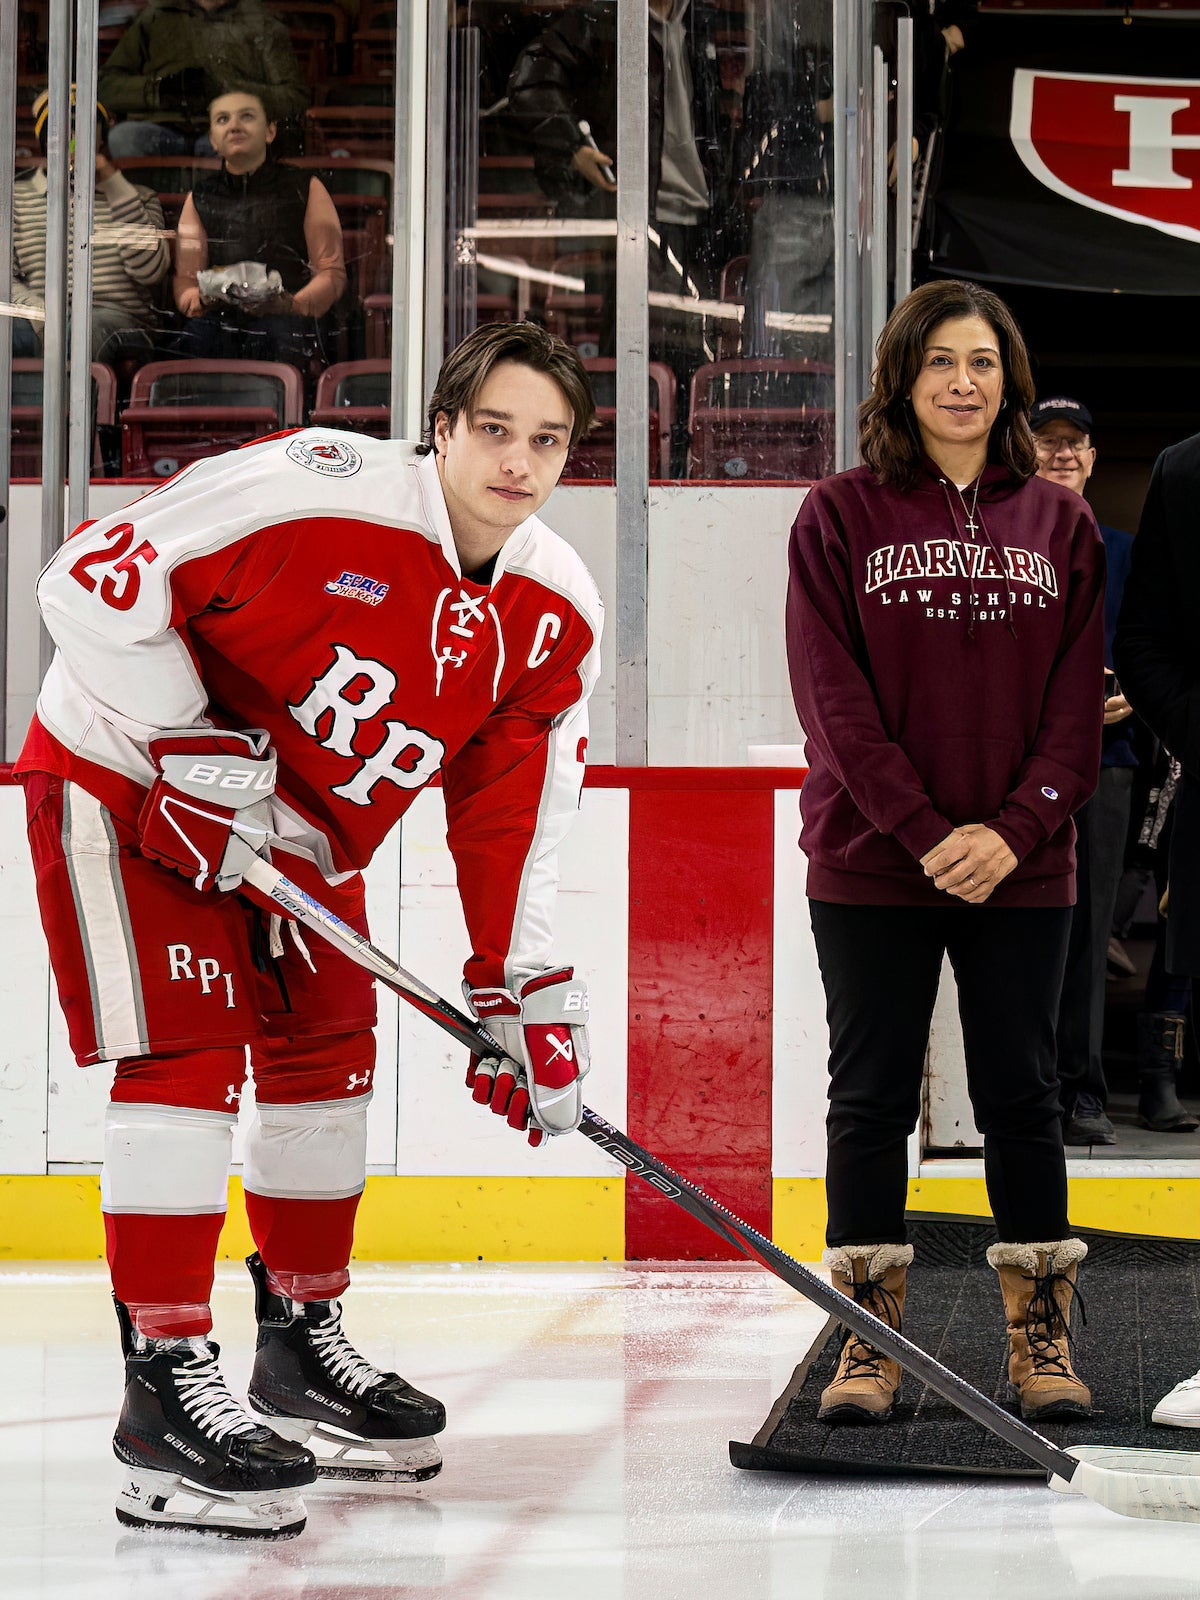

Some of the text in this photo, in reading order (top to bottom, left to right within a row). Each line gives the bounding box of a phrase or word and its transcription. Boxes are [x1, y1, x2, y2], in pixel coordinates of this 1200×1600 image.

[69, 523, 158, 612] 25
[865, 539, 1059, 598] HARVARD
[337, 572, 389, 597] ECAC
[881, 590, 933, 604] LAW
[951, 592, 1047, 608] SCHOOL
[926, 608, 960, 620] EST.
[527, 613, 561, 669] C
[271, 886, 307, 918] UER
[166, 943, 237, 1010] RPI
[305, 1389, 353, 1417] BAUER
[163, 1433, 206, 1466] BAUER
